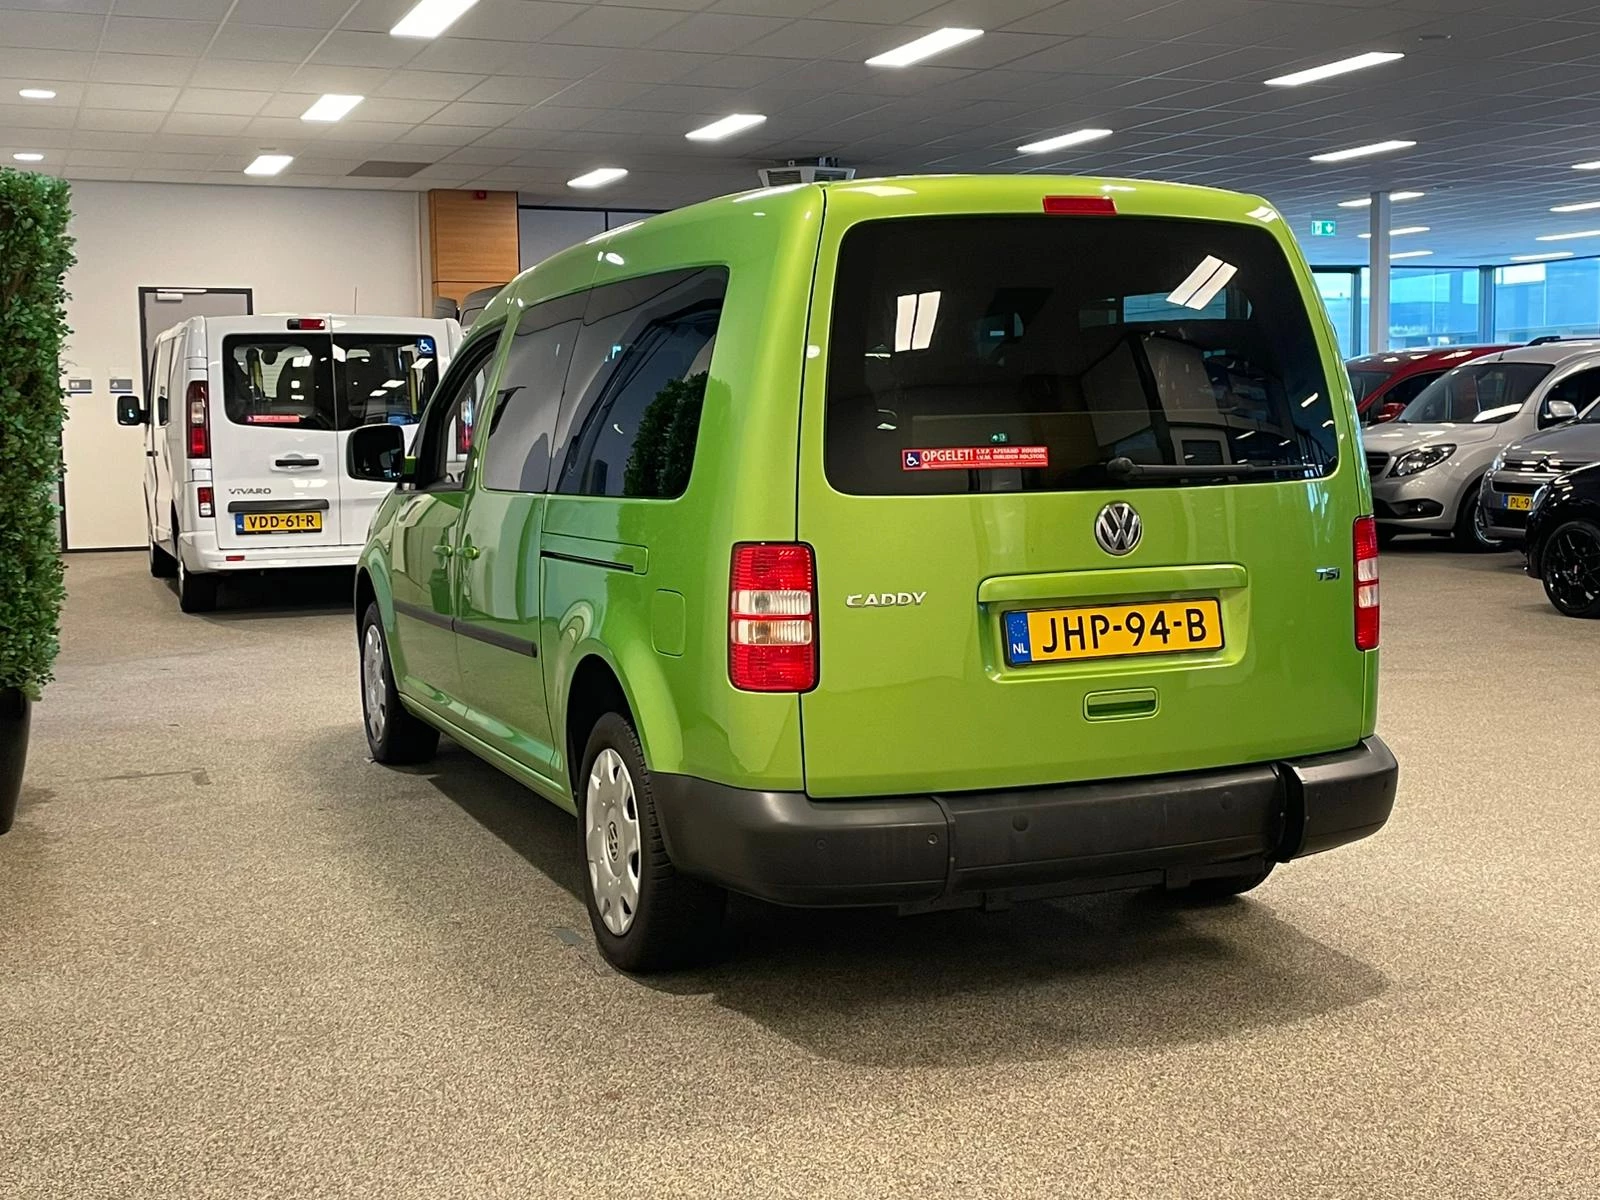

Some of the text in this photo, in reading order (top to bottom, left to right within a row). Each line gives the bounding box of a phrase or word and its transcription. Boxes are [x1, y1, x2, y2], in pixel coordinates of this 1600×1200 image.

[921, 449, 974, 461] OPGELET!
[228, 487, 272, 495] VIVARO
[248, 514, 315, 529] VDD-61-R
[846, 591, 927, 607] CADDY
[1041, 608, 1207, 654] JHP-94-B
[1012, 643, 1029, 655] NL
